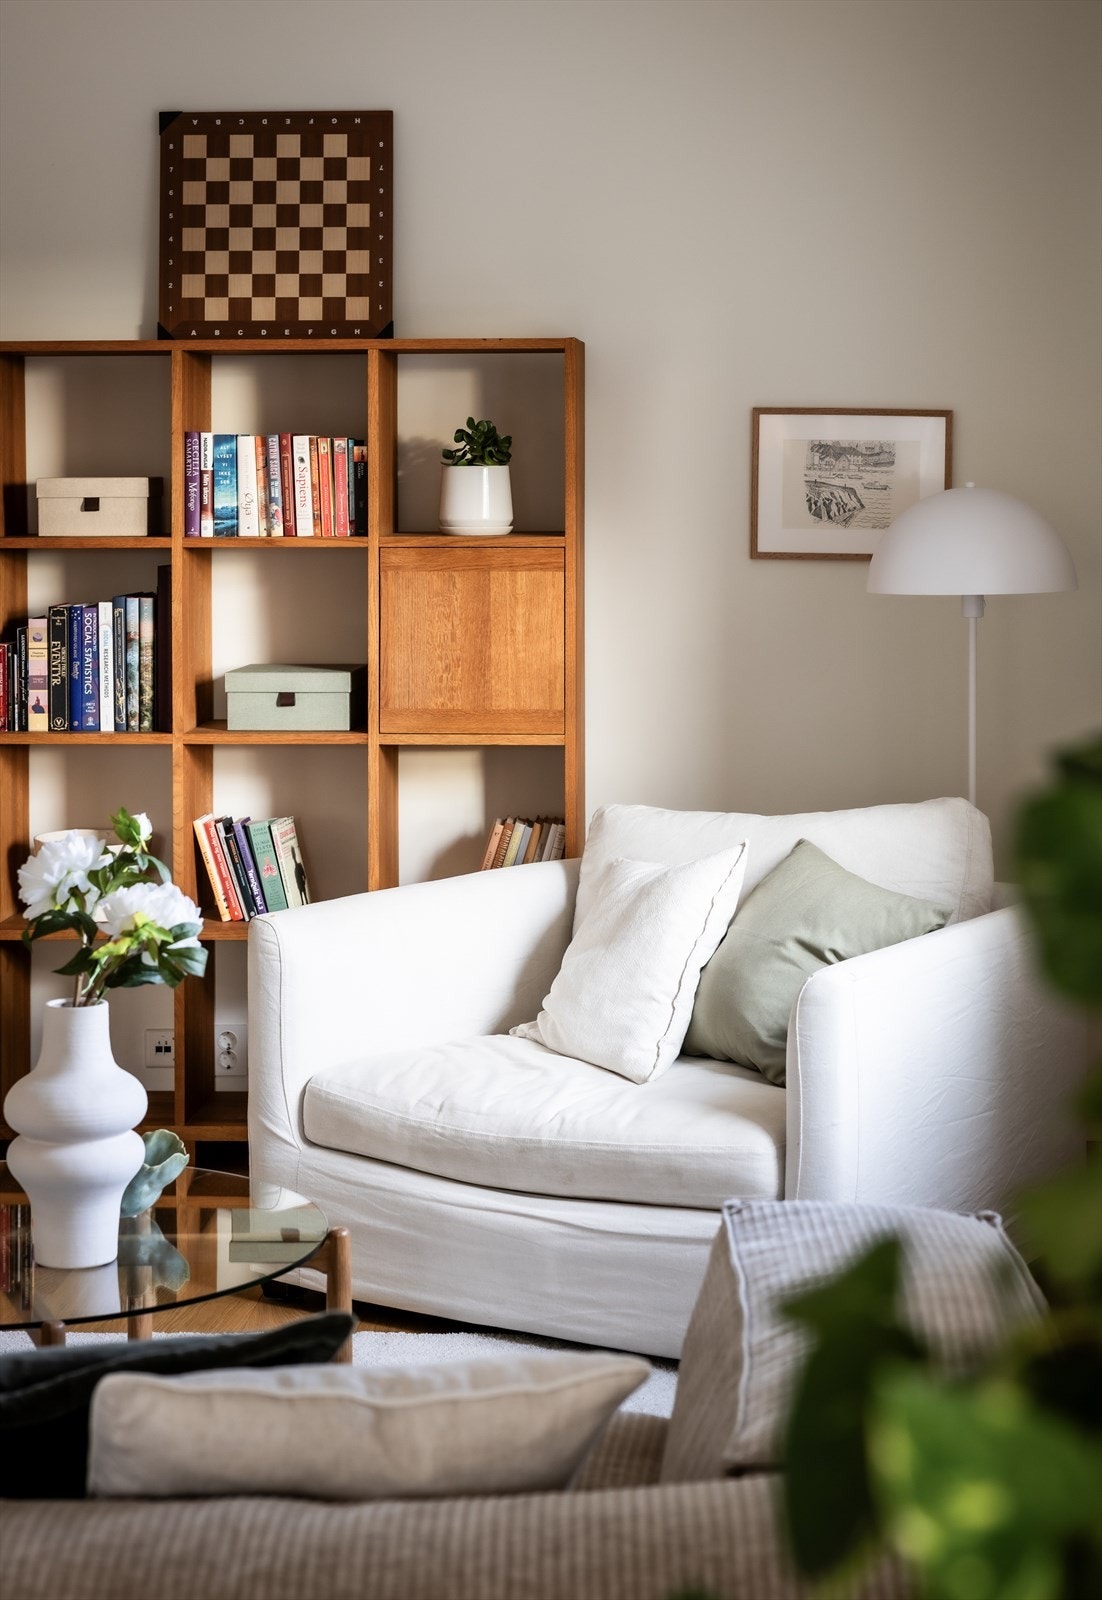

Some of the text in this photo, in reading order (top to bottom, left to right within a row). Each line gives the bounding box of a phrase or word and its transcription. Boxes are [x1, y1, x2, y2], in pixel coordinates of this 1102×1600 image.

[192, 438, 200, 476] CECILIA
[268, 437, 277, 460] CATRIN
[187, 482, 198, 511] Mofongo
[241, 492, 254, 516] Øya
[296, 466, 308, 508] Sapiens
[84, 612, 92, 645] SOCIAL
[52, 641, 61, 686] EVENTYR
[84, 647, 92, 695] STATISTICS
